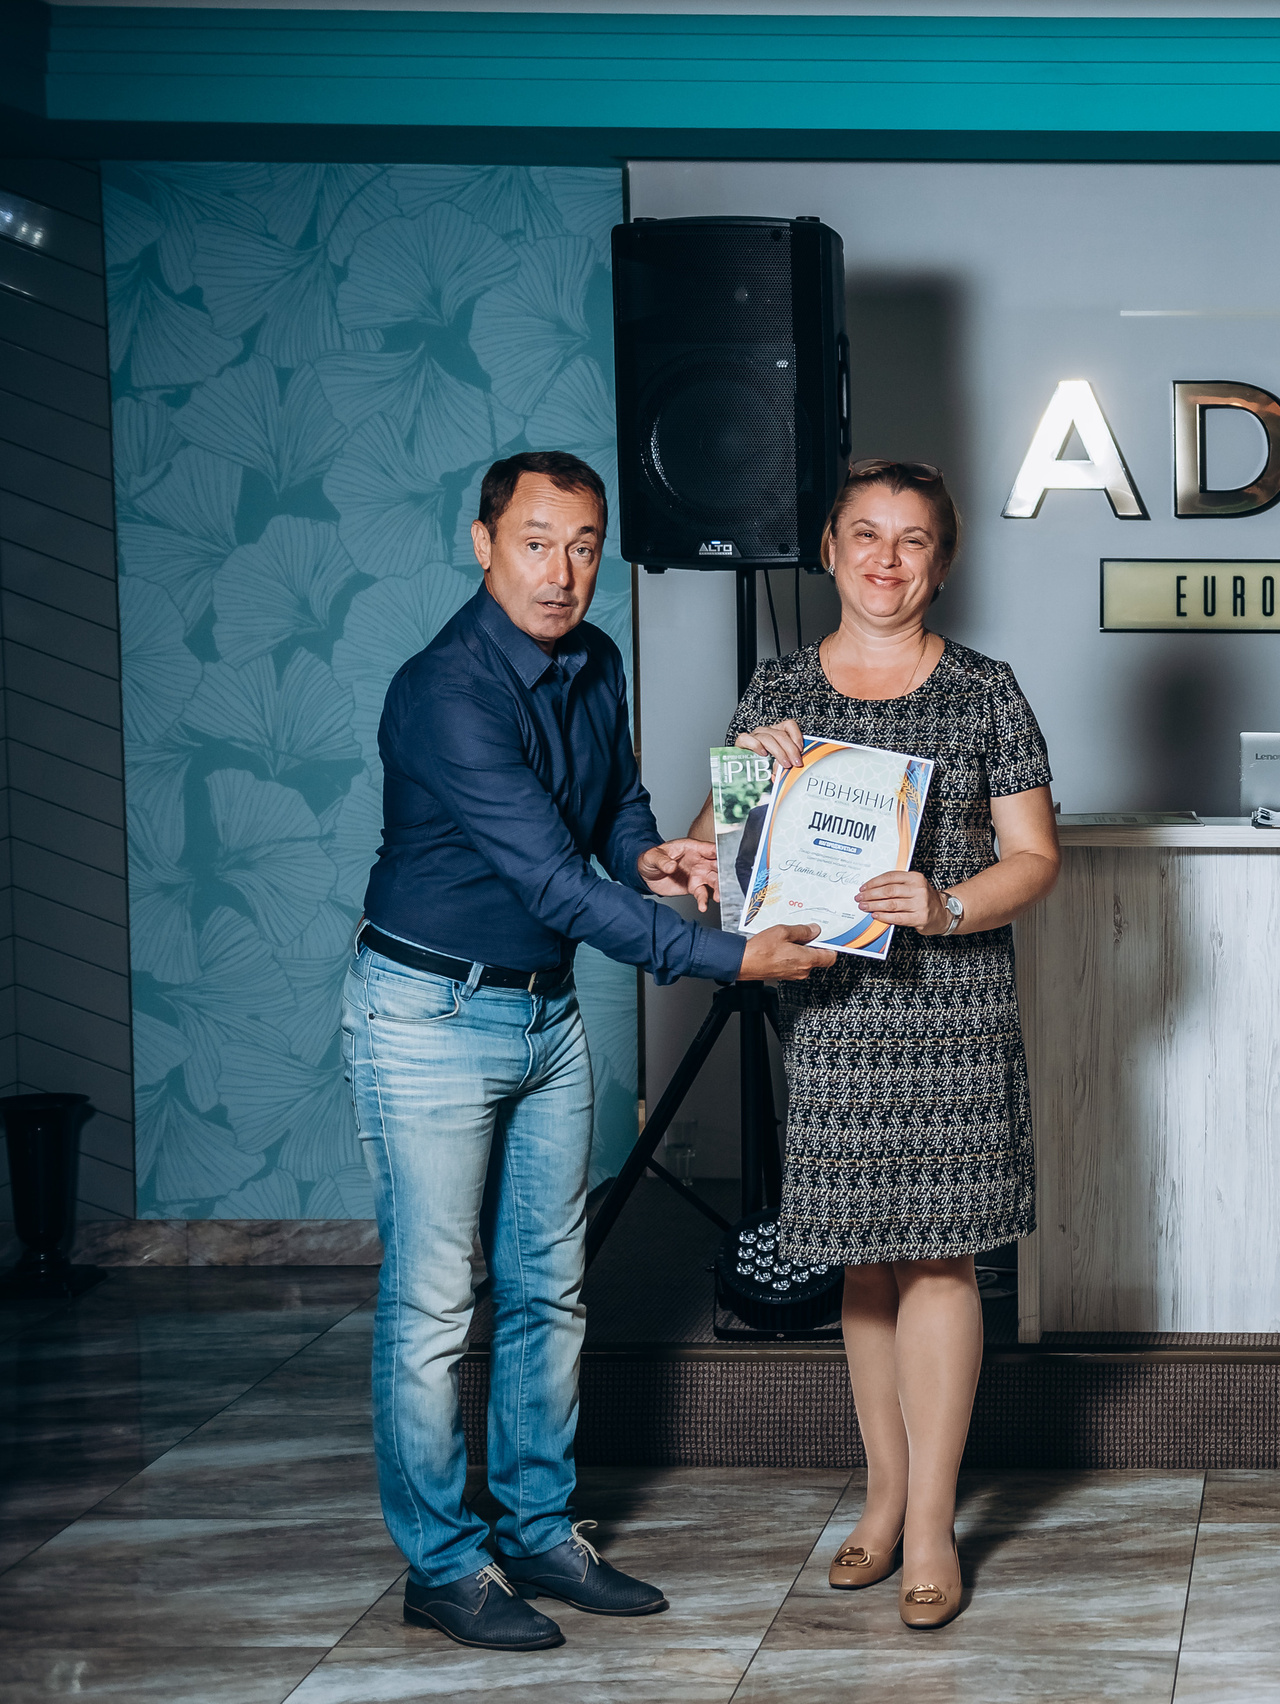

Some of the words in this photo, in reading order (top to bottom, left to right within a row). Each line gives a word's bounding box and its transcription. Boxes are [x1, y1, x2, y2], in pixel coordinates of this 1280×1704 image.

[699, 543, 732, 552] ALTO
[727, 759, 772, 783] РІВ
[806, 778, 894, 811] РІВНЯНИ
[808, 811, 877, 842] ДИПЛОМ
